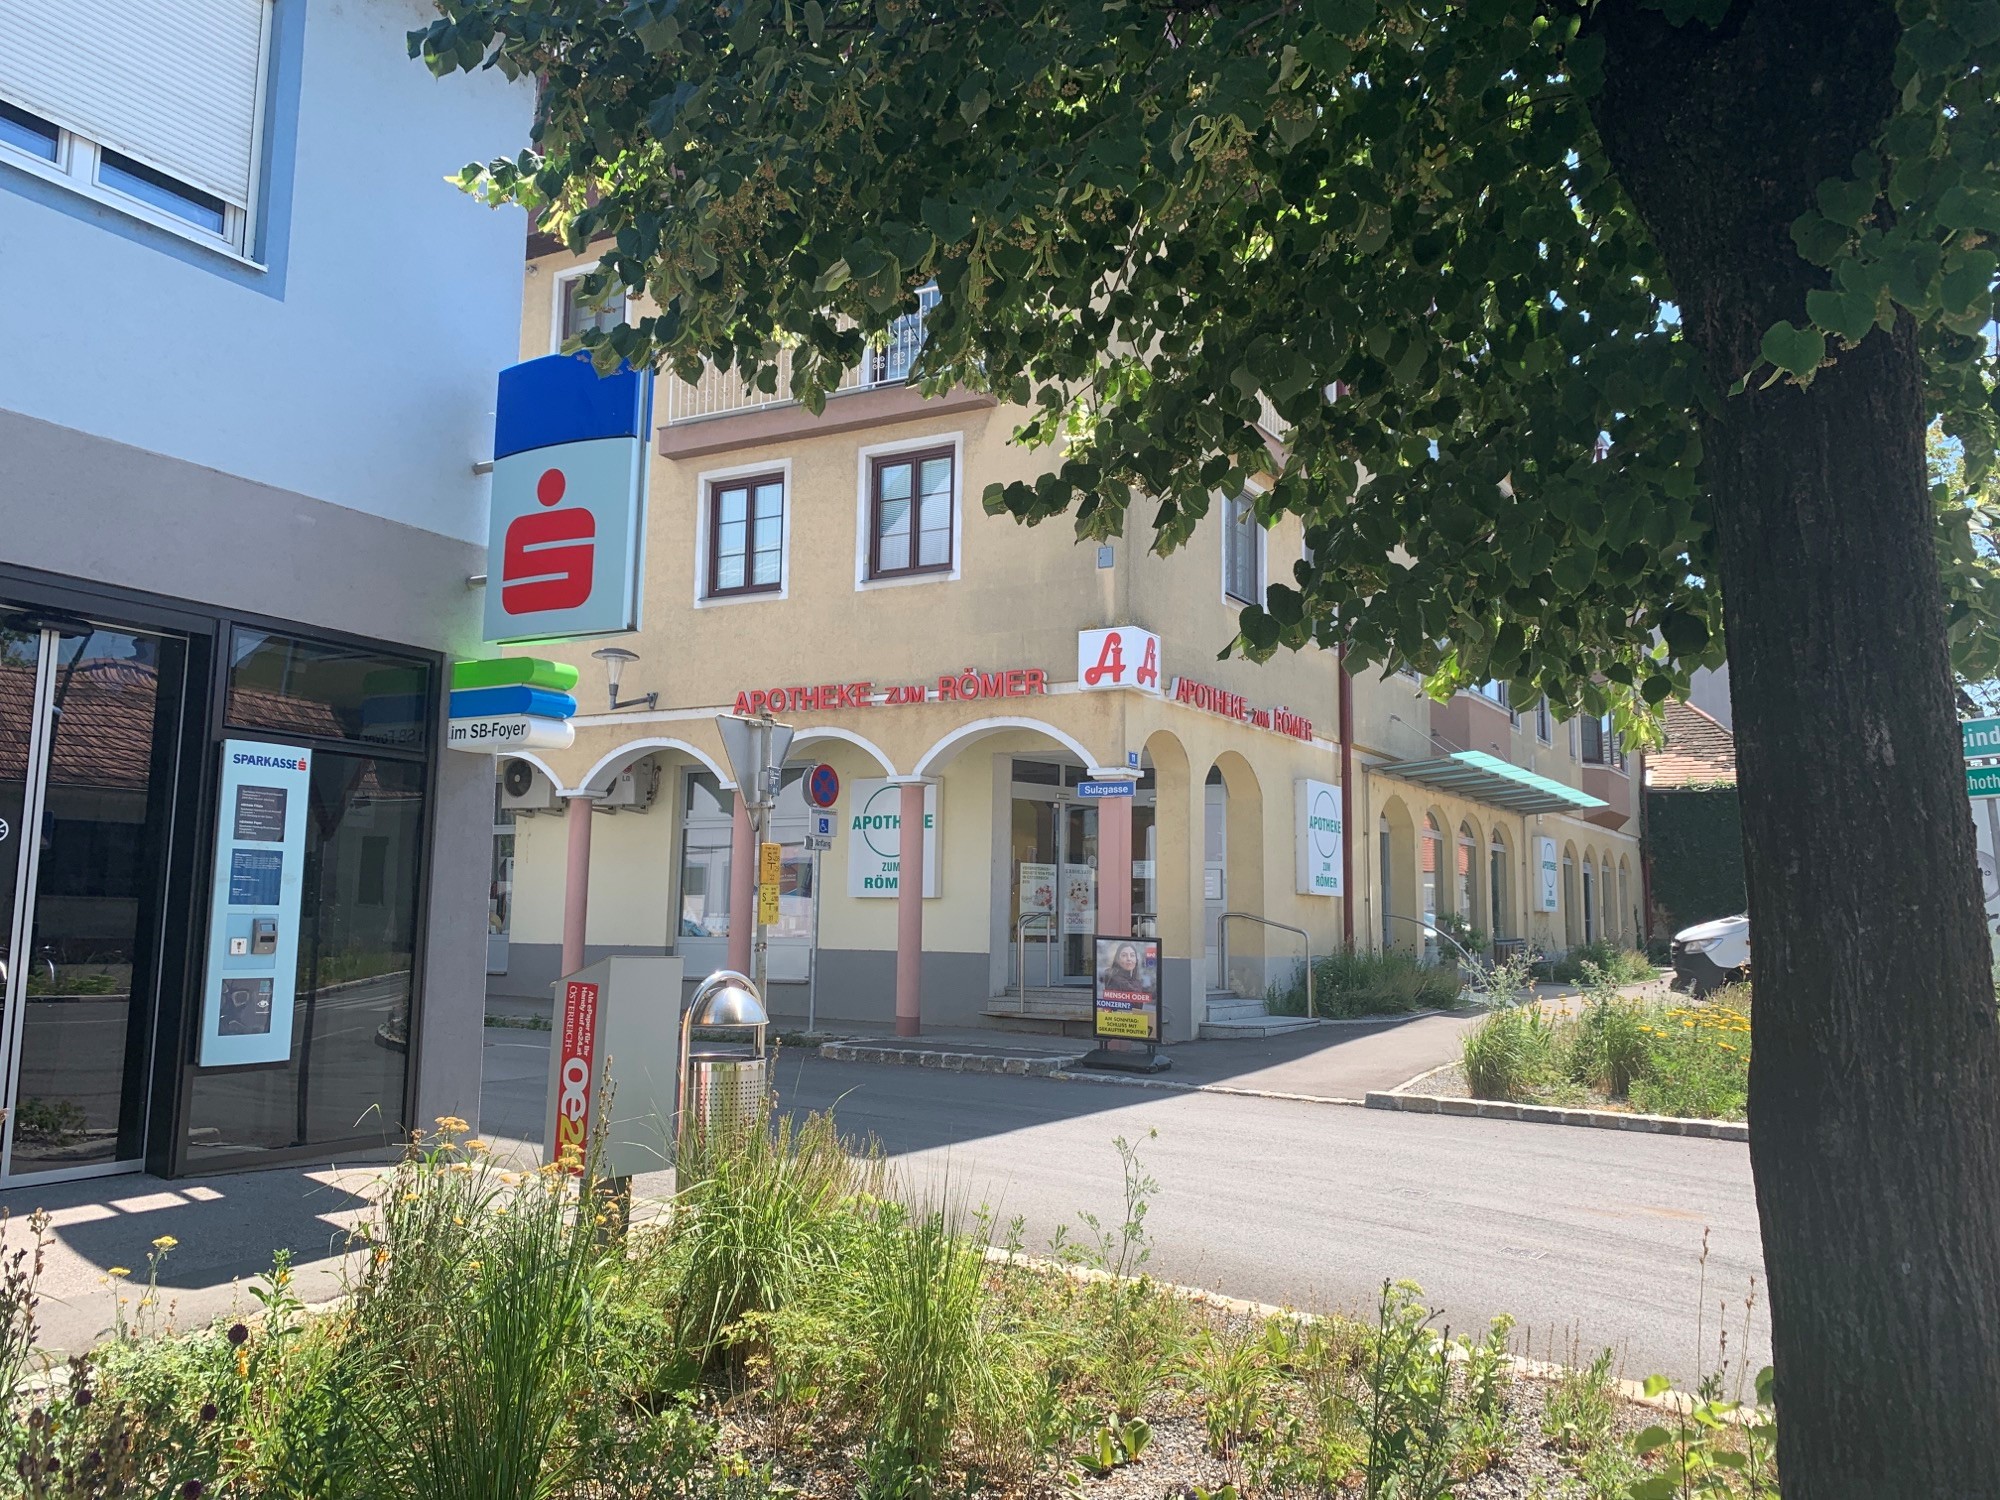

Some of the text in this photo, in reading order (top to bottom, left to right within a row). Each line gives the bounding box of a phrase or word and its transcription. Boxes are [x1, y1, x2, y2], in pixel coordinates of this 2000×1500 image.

[733, 667, 1046, 715] APOTHEKE ZUM RÖMER
[1176, 676, 1313, 741] APOTHEKE ZUM RÖMER
[470, 722, 526, 740] SB-Foyer
[232, 753, 297, 770] SPARKASSE
[1084, 785, 1129, 795] Sulzgasse
[1968, 774, 2000, 791] hoth
[852, 814, 934, 830] APOTHE
[1309, 815, 1341, 834] APOTHEKE
[815, 839, 831, 850] Anfang
[882, 862, 900, 872] ZUM
[864, 874, 898, 889] RÖM
[1315, 874, 1338, 888] RÖMER
[579, 986, 588, 1012] Handy
[1103, 991, 1150, 1001] MENSCH ODER
[1096, 1000, 1131, 1009] KONZERN?
[584, 1004, 593, 1032] ePaper
[1098, 1026, 1126, 1034] GEKAUFTER
[576, 1026, 584, 1057] oe24.at
[583, 1032, 591, 1045] für
